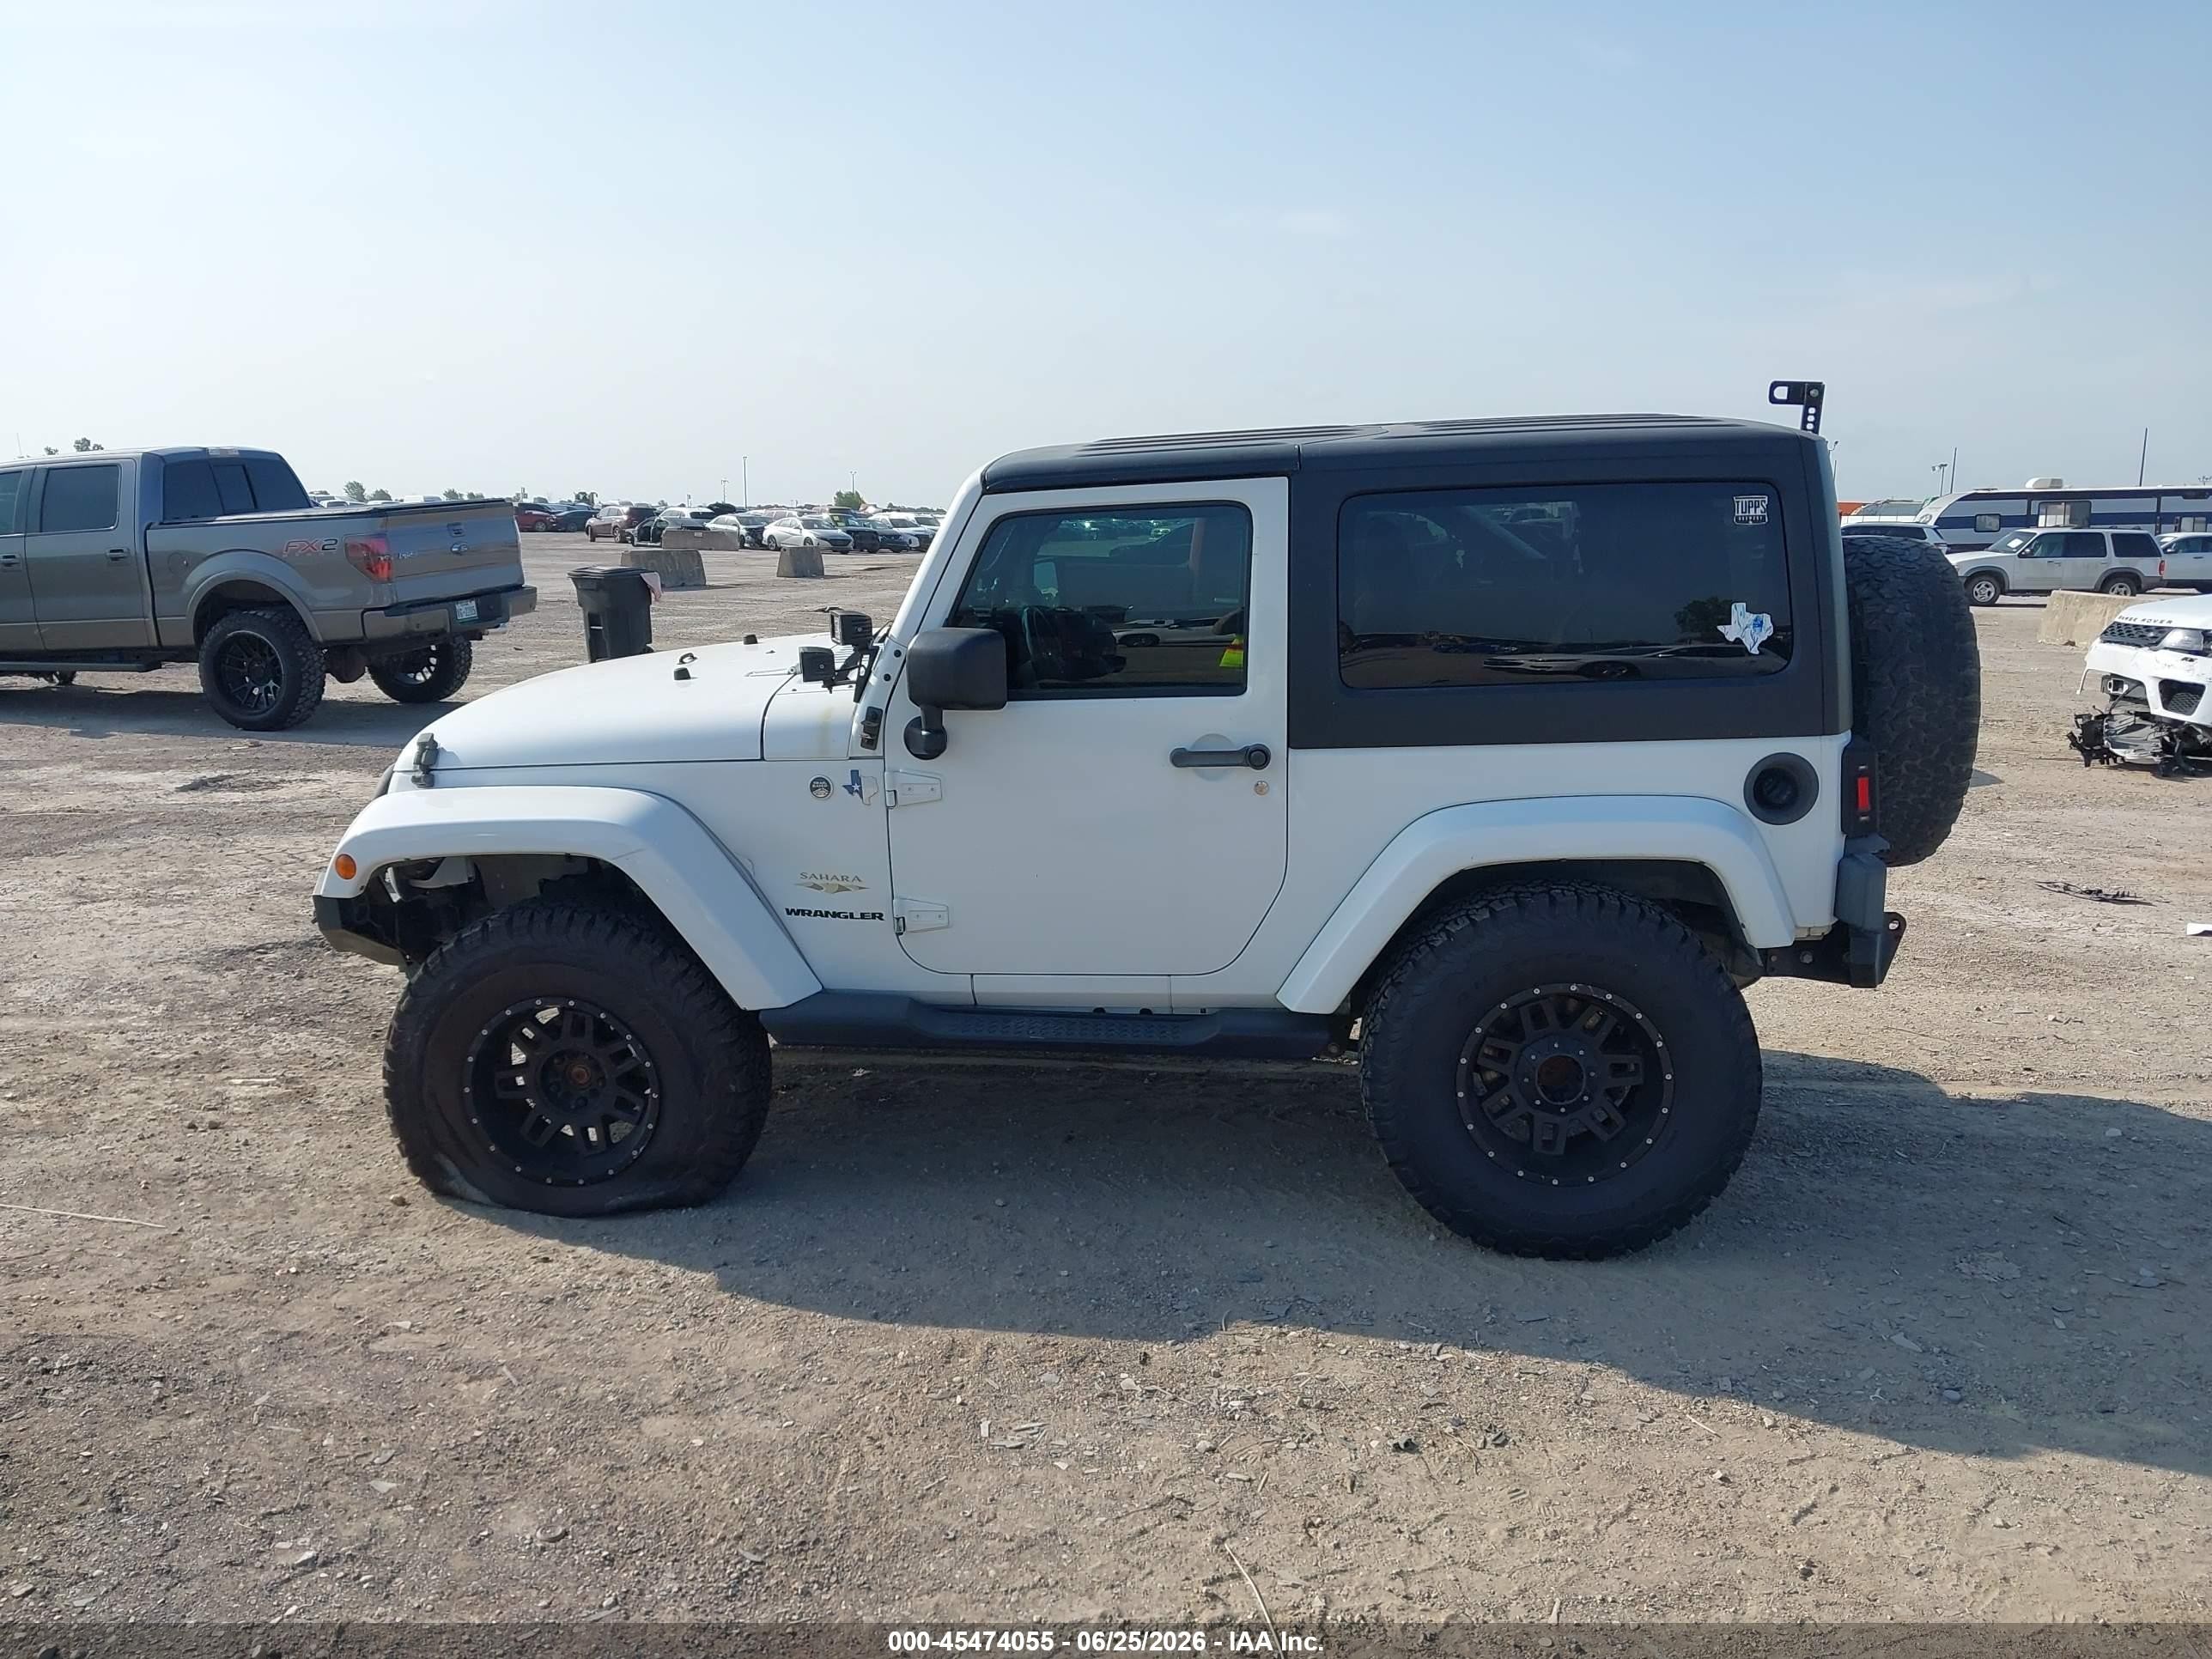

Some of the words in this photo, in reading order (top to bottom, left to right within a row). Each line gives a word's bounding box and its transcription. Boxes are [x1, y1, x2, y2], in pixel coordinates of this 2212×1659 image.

[1735, 500, 1766, 514] TUPPS
[283, 538, 338, 552] FX2
[799, 872, 863, 883] SAHARA
[785, 907, 885, 921] WRANGLER
